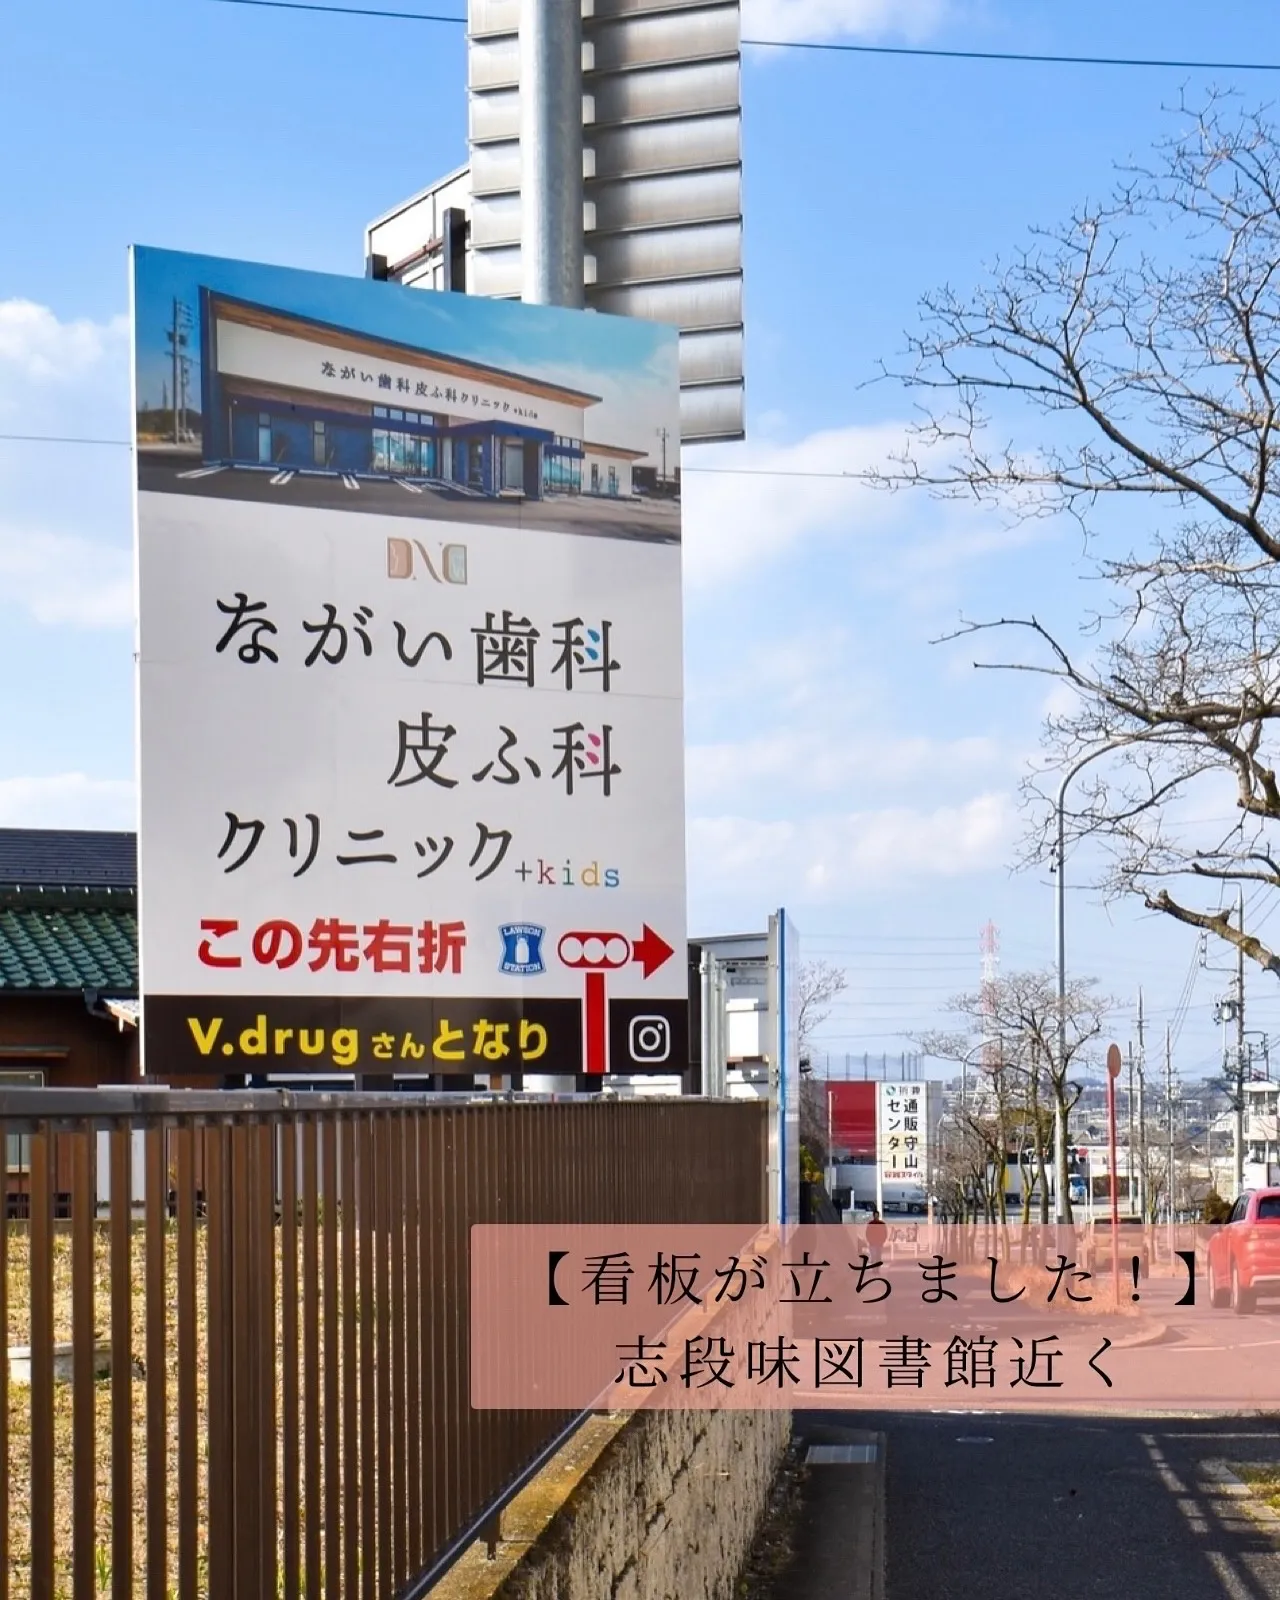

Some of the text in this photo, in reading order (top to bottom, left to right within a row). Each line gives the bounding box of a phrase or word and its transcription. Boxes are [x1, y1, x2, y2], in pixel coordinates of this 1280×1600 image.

[215, 592, 621, 692] ながい歯科
[387, 712, 621, 797] 皮ふ科
[197, 917, 466, 975] この先右折
[502, 961, 542, 973] STATION
[187, 1015, 359, 1065] V.drug
[888, 1099, 901, 1169] センター
[904, 1098, 918, 1169] 通販守山
